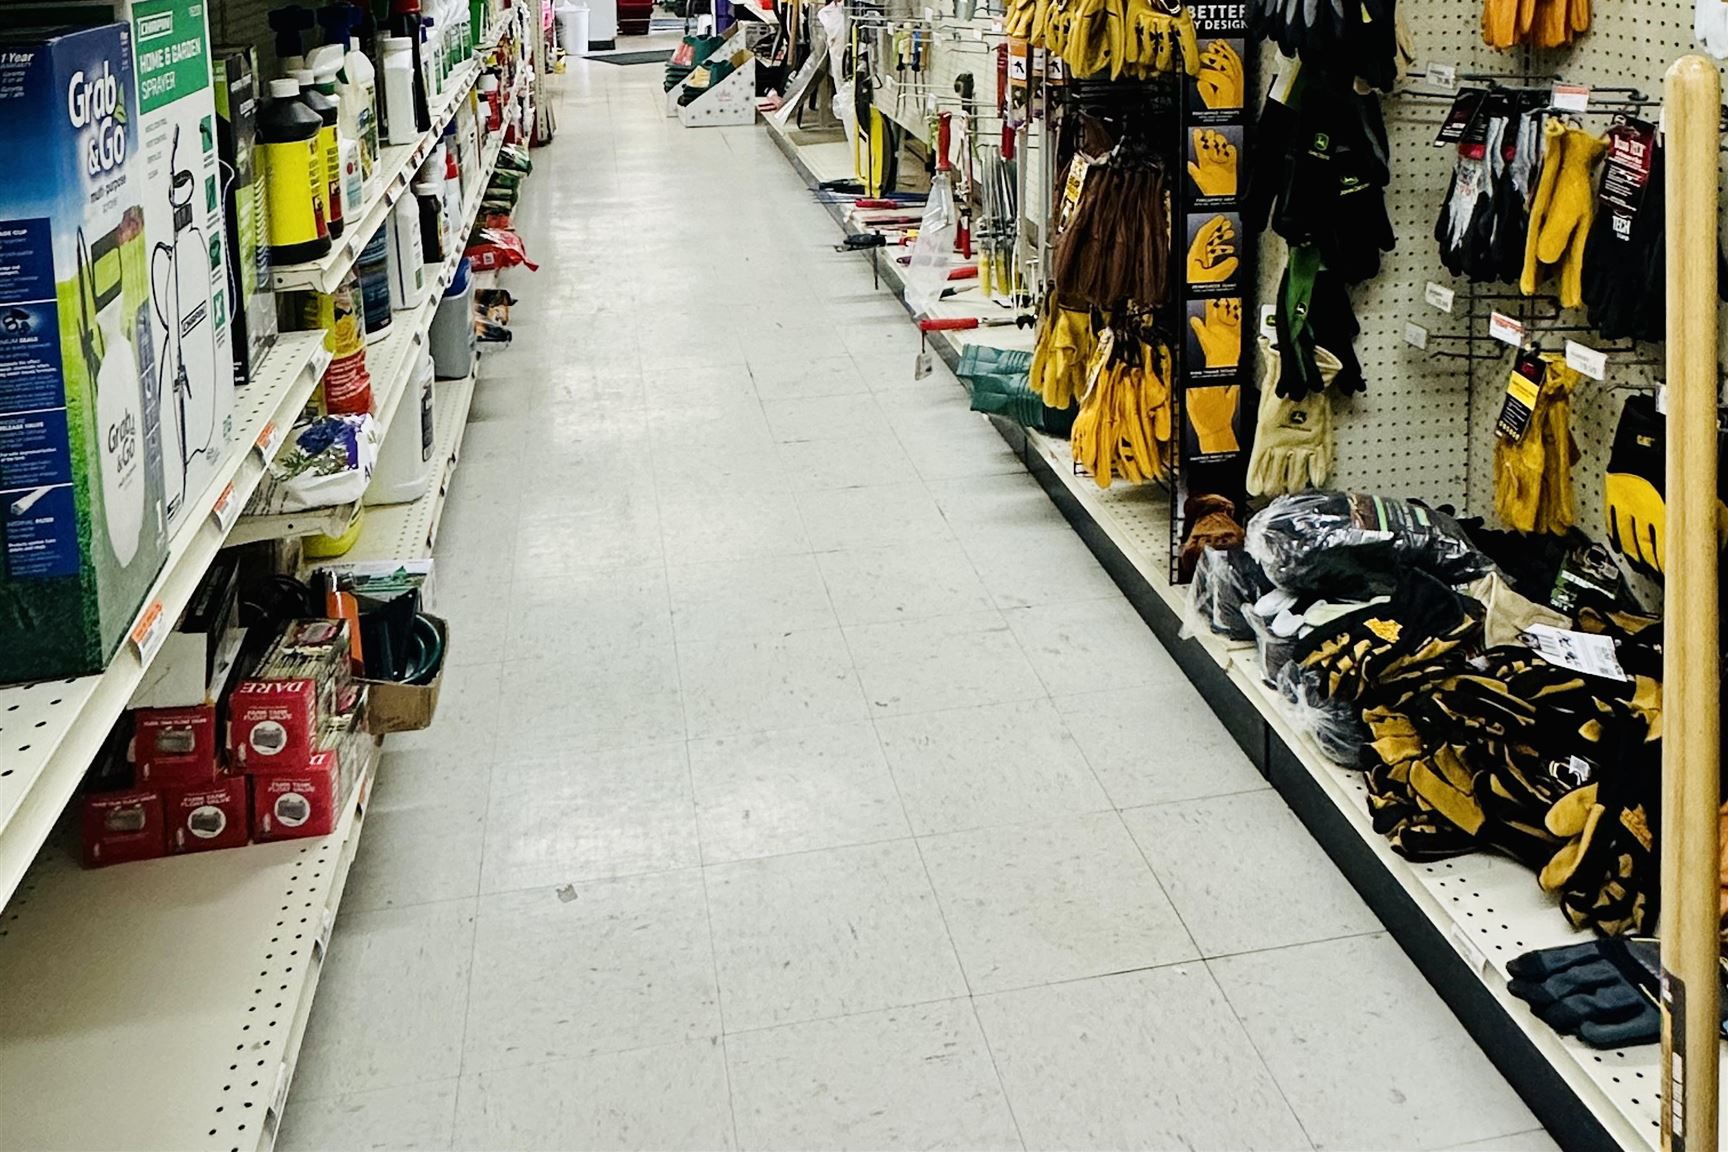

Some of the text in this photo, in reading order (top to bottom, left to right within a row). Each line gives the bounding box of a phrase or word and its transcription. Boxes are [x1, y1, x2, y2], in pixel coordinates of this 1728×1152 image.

[9, 52, 34, 63] Year
[140, 49, 164, 74] HOME
[172, 37, 201, 63] GARDEN
[69, 60, 116, 128] Grab
[141, 71, 175, 99] SPRAYER
[240, 682, 304, 694] DARE
